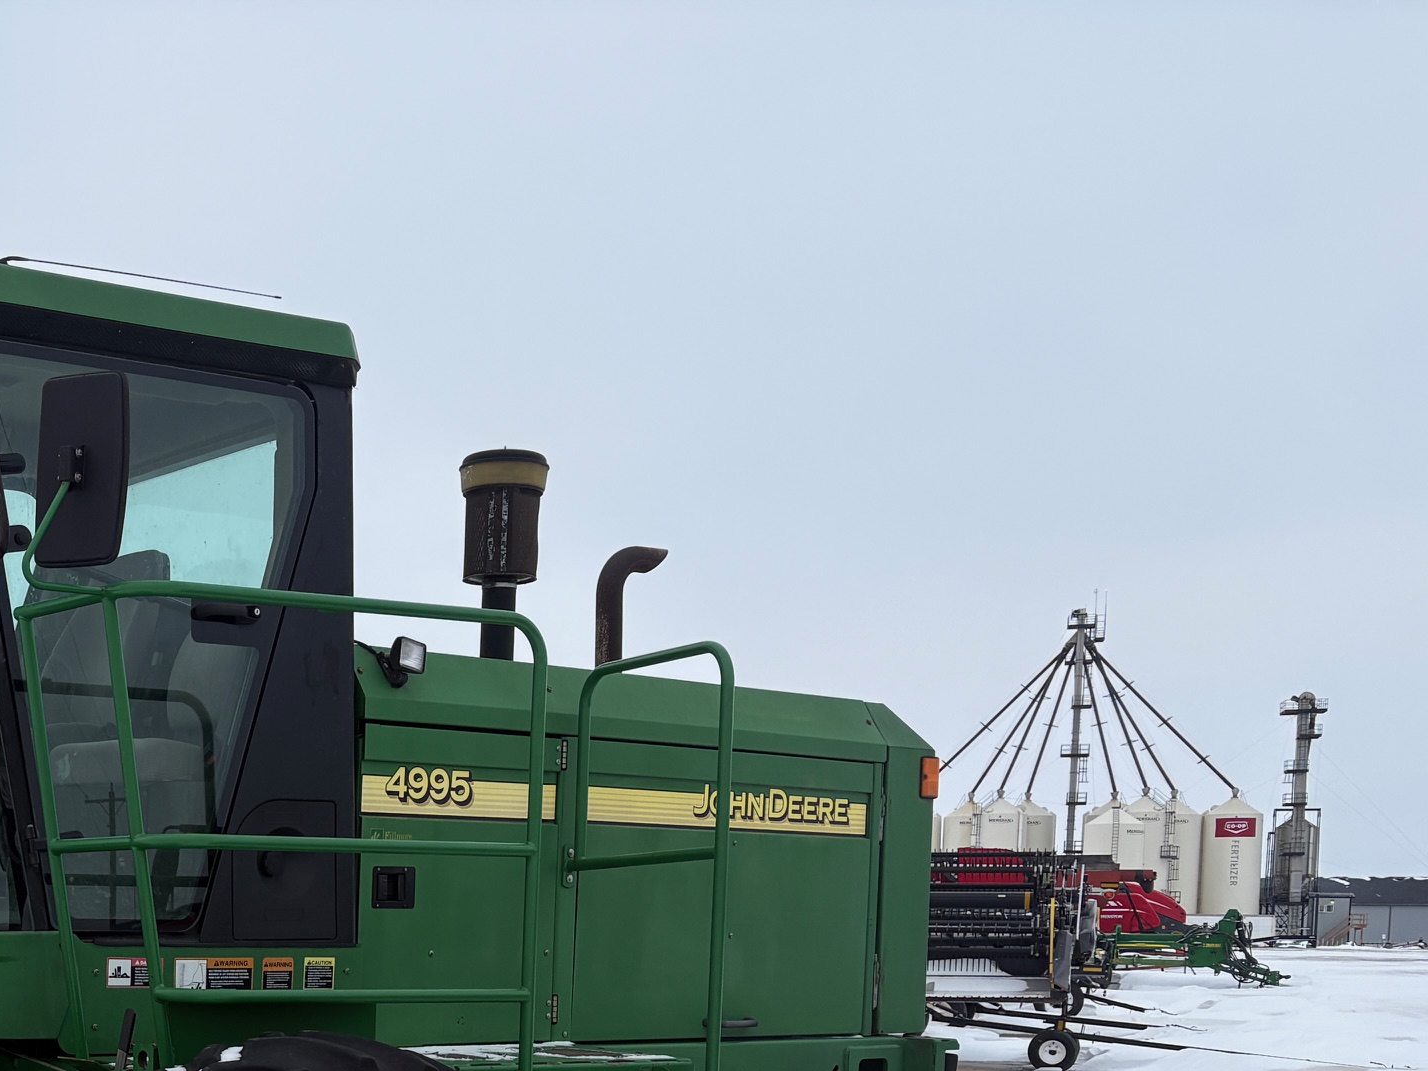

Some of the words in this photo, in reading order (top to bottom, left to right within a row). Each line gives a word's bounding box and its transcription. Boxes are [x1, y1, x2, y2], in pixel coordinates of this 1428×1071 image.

[385, 766, 473, 807] 4995
[768, 788, 850, 825] DEERE
[1229, 840, 1239, 886] FERTILIZER
